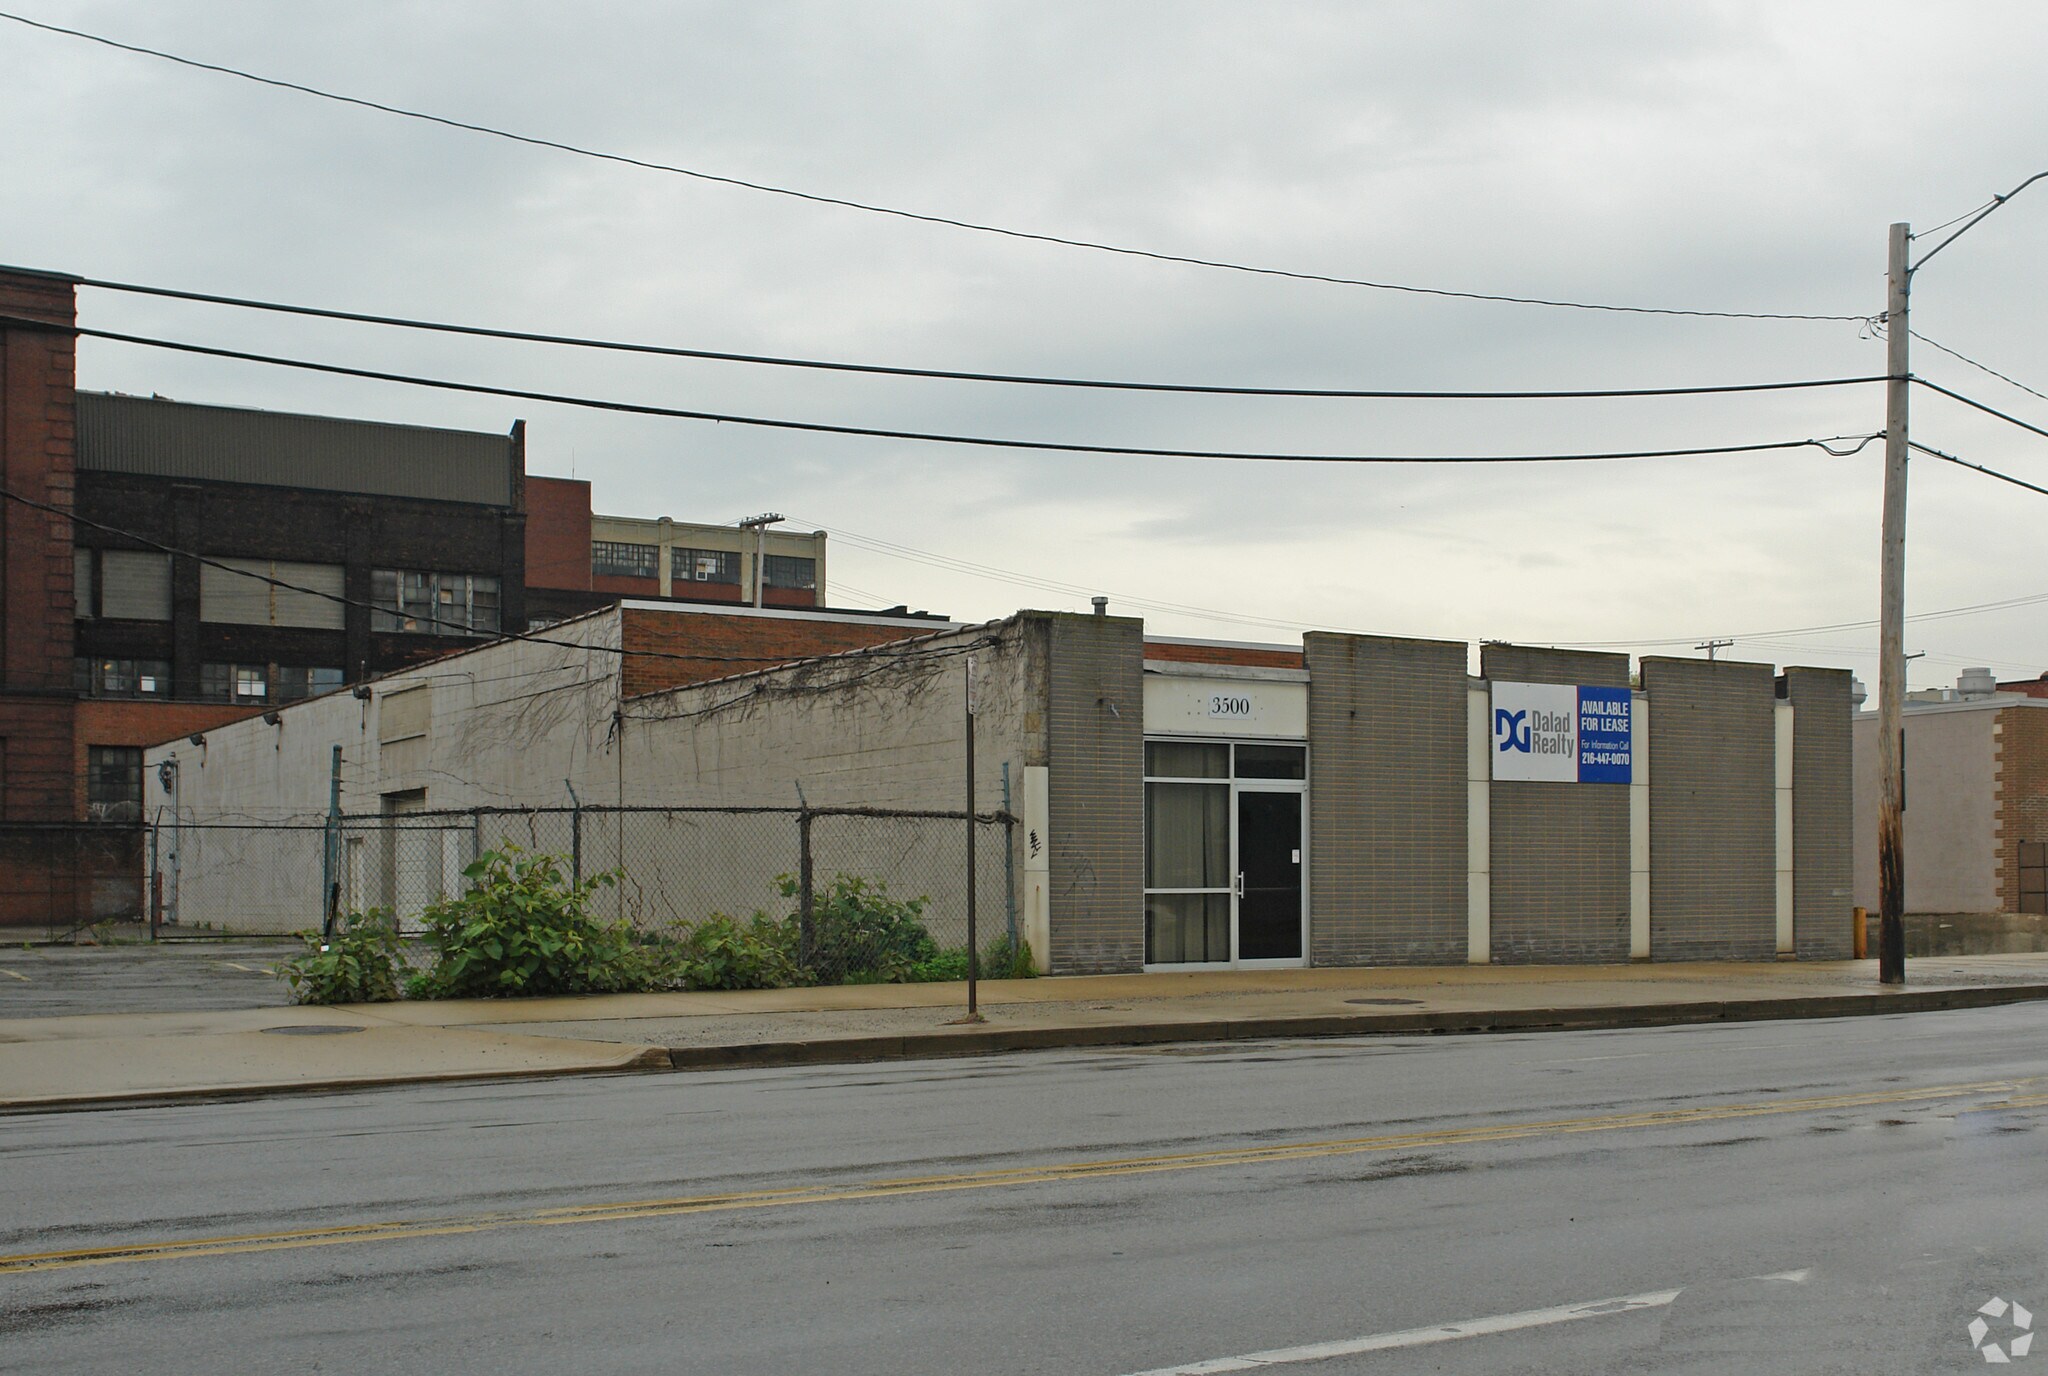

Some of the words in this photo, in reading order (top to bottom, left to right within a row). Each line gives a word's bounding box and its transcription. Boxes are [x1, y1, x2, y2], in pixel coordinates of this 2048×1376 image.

[1212, 697, 1250, 715] 3500
[1581, 700, 1629, 716] AVAILABLE
[1532, 710, 1571, 733] Dalad
[1581, 717, 1598, 731] FOR
[1601, 718, 1629, 732] LEASE
[1532, 733, 1575, 758] Realty
[1581, 739, 1590, 749] For
[1591, 740, 1619, 750] Information
[1619, 741, 1629, 750] Call
[1582, 751, 1630, 765] 216-447-0070
